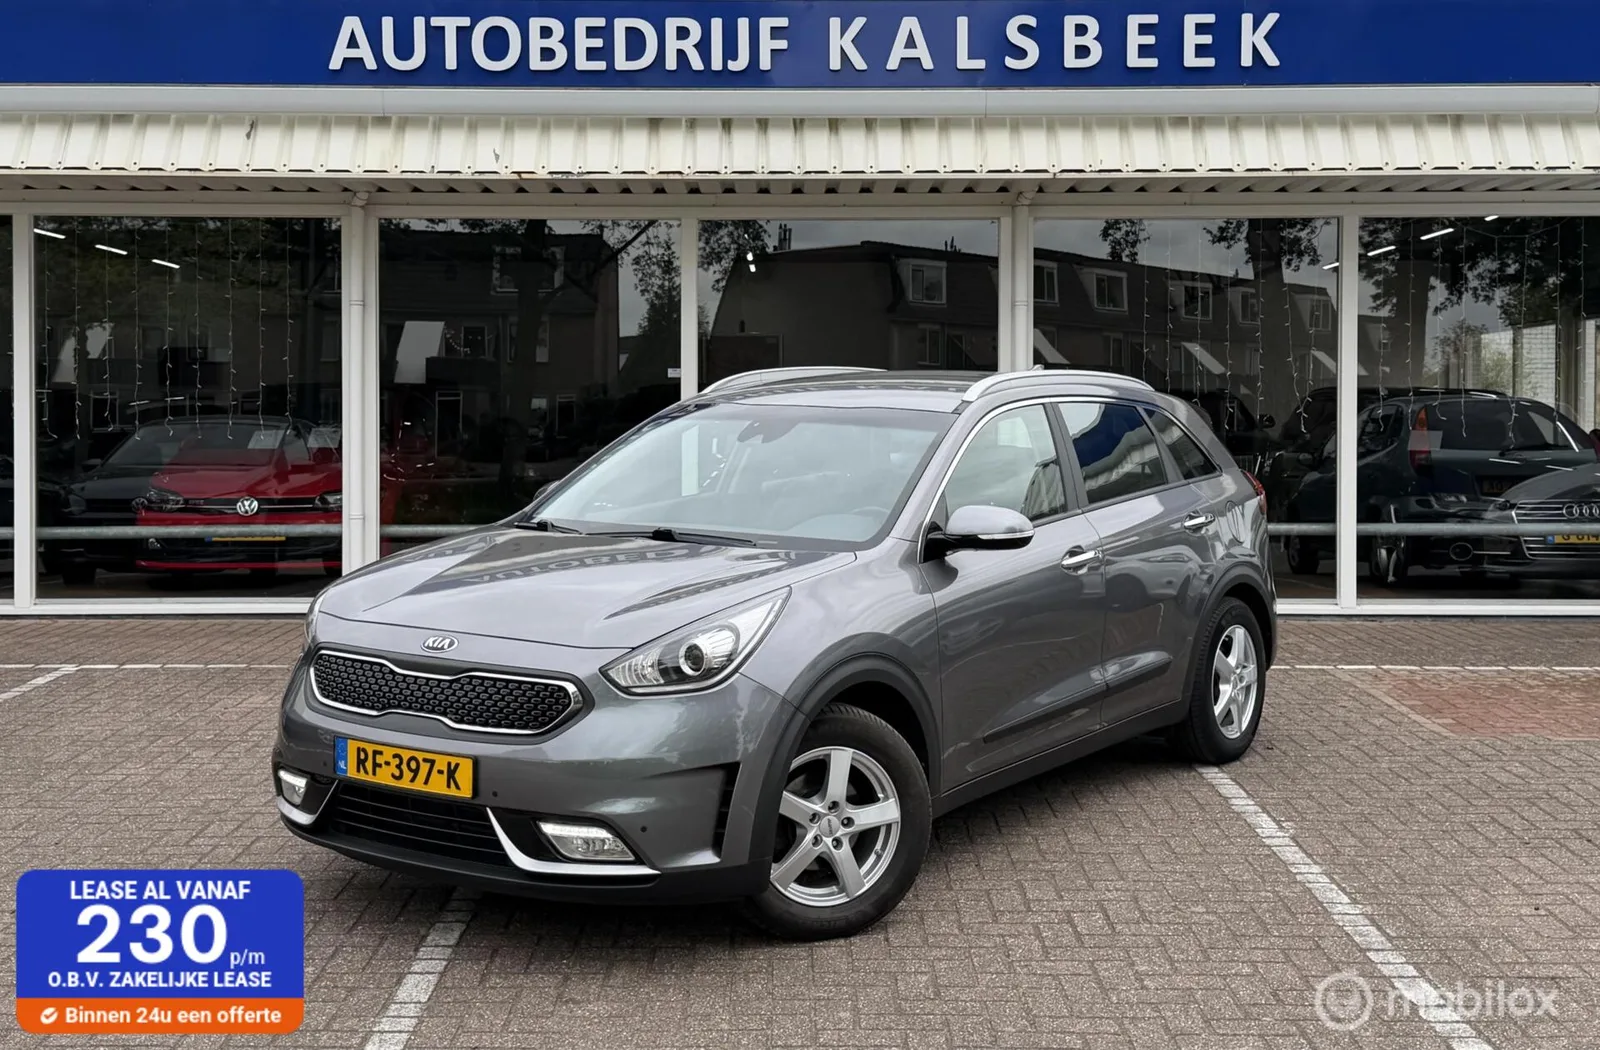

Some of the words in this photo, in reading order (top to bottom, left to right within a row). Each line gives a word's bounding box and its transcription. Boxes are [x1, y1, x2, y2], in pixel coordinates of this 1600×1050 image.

[328, 15, 789, 72] AUTOBEDRIJF
[829, 12, 1280, 71] KALSBEEK
[423, 636, 452, 649] KIA
[356, 746, 461, 791] RF-397-K
